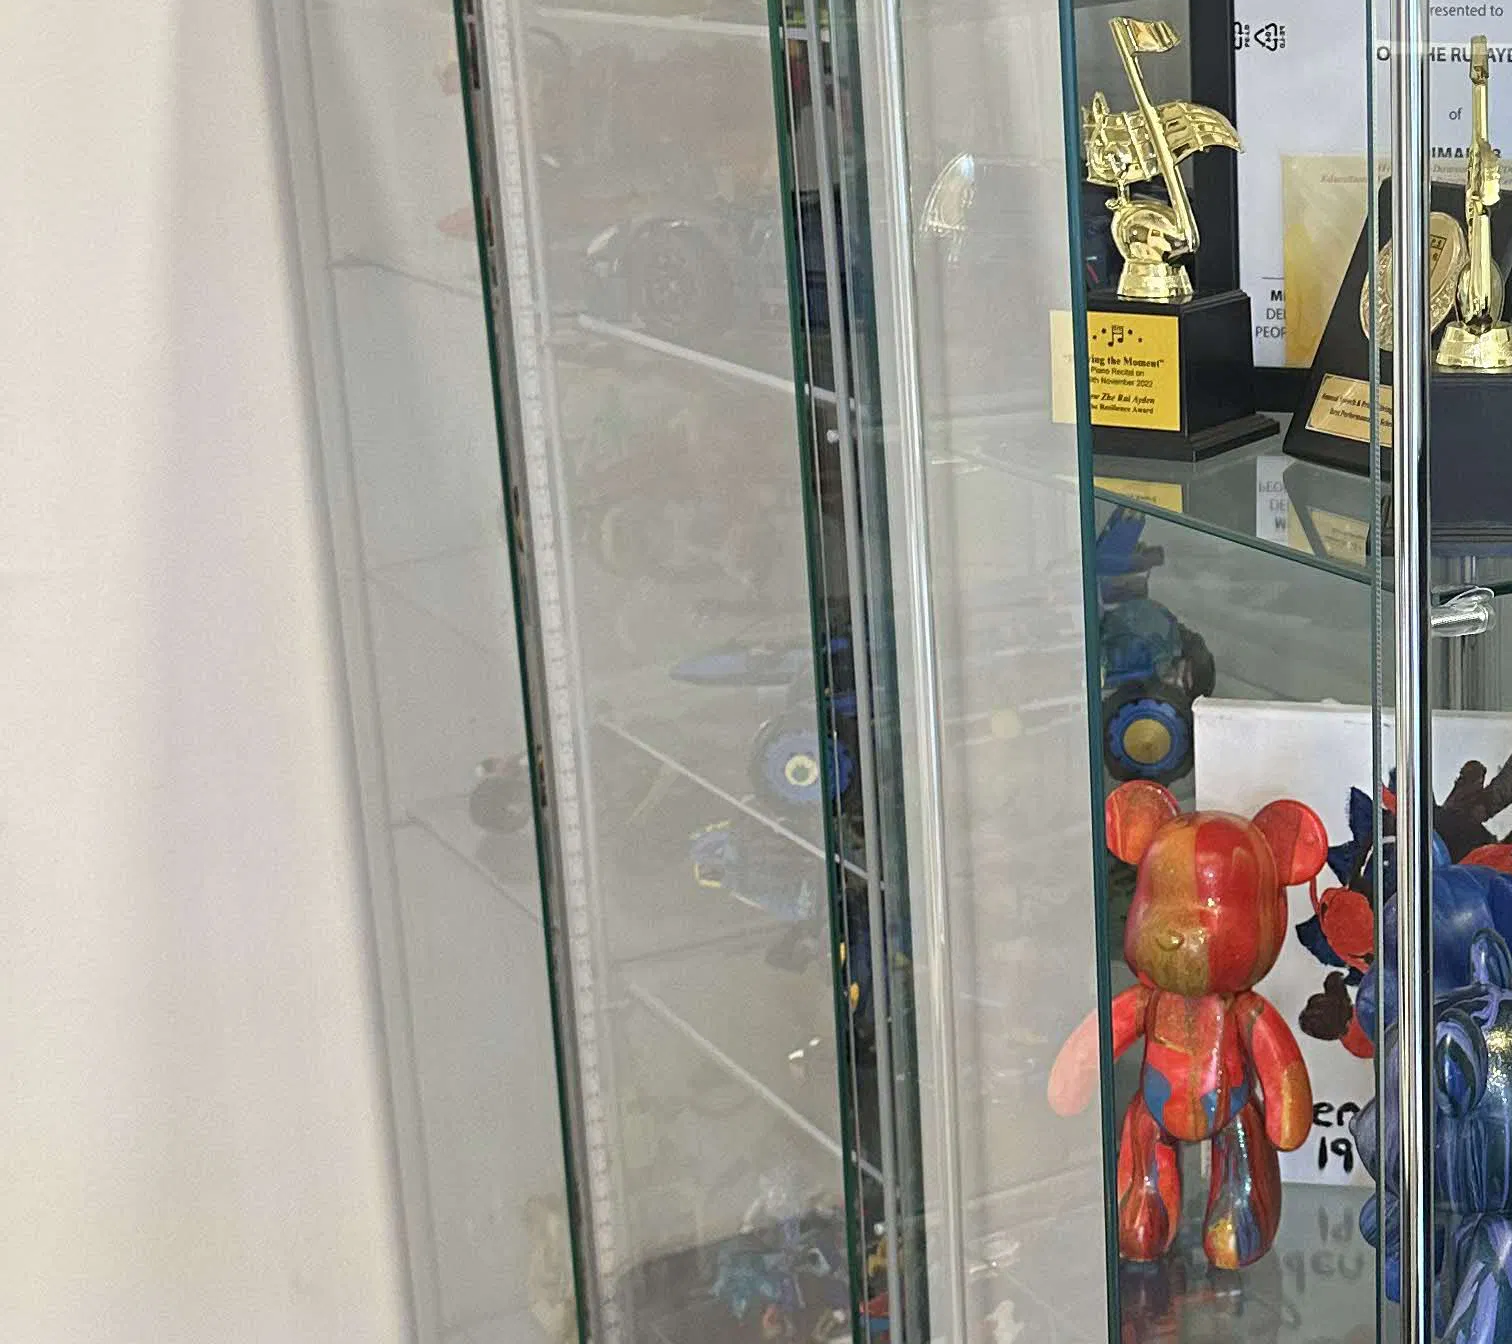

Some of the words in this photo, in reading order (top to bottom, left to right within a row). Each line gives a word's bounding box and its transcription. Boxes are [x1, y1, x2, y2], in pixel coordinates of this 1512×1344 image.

[1430, 4, 1486, 17] resented
[1490, 5, 1504, 16] to
[1449, 107, 1462, 120] of
[1107, 356, 1121, 366] the
[1100, 376, 1135, 387] November
[1132, 406, 1154, 415] Award
